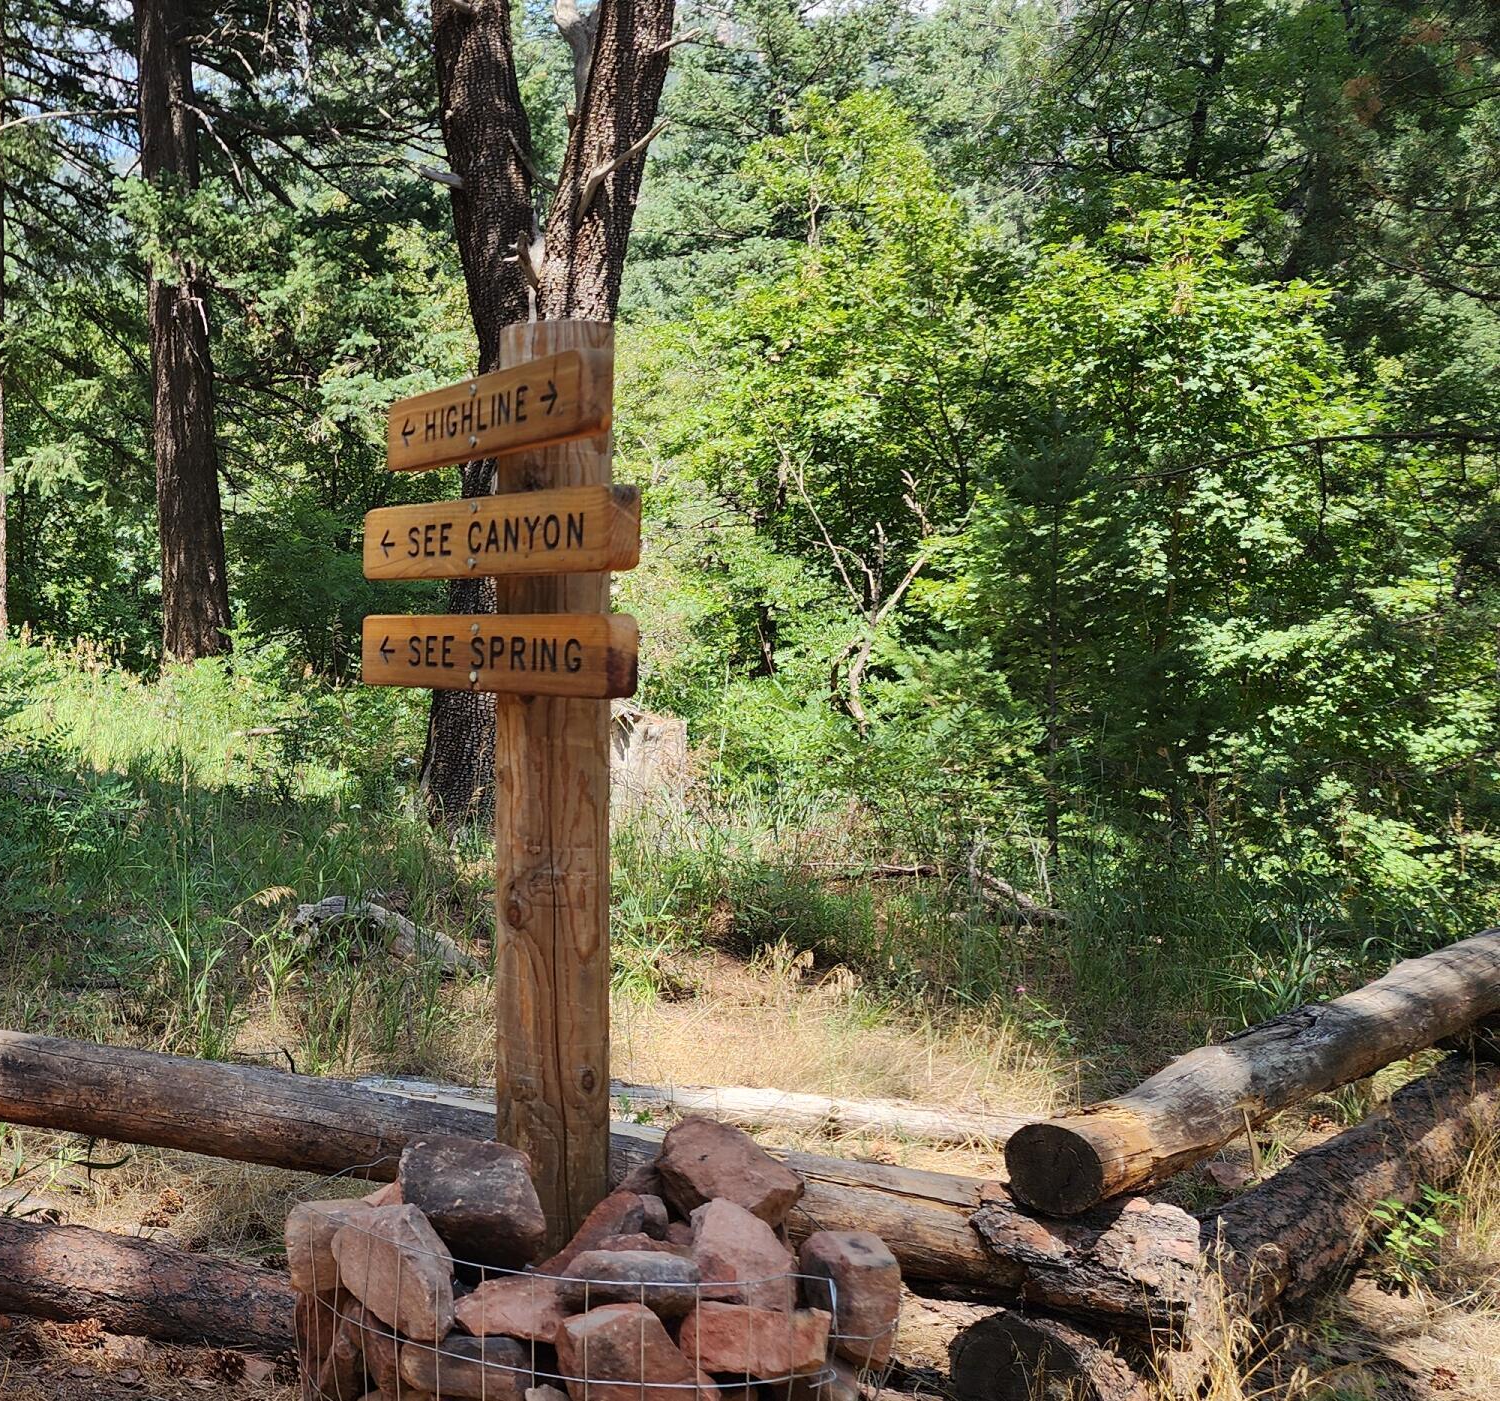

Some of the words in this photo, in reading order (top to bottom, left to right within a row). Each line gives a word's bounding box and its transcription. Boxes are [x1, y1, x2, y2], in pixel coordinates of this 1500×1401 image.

[424, 385, 529, 442] HIGHLINE
[407, 523, 453, 558] SEE
[467, 512, 584, 555] CANYON
[407, 635, 455, 668] SEE
[470, 636, 583, 673] SPRING
